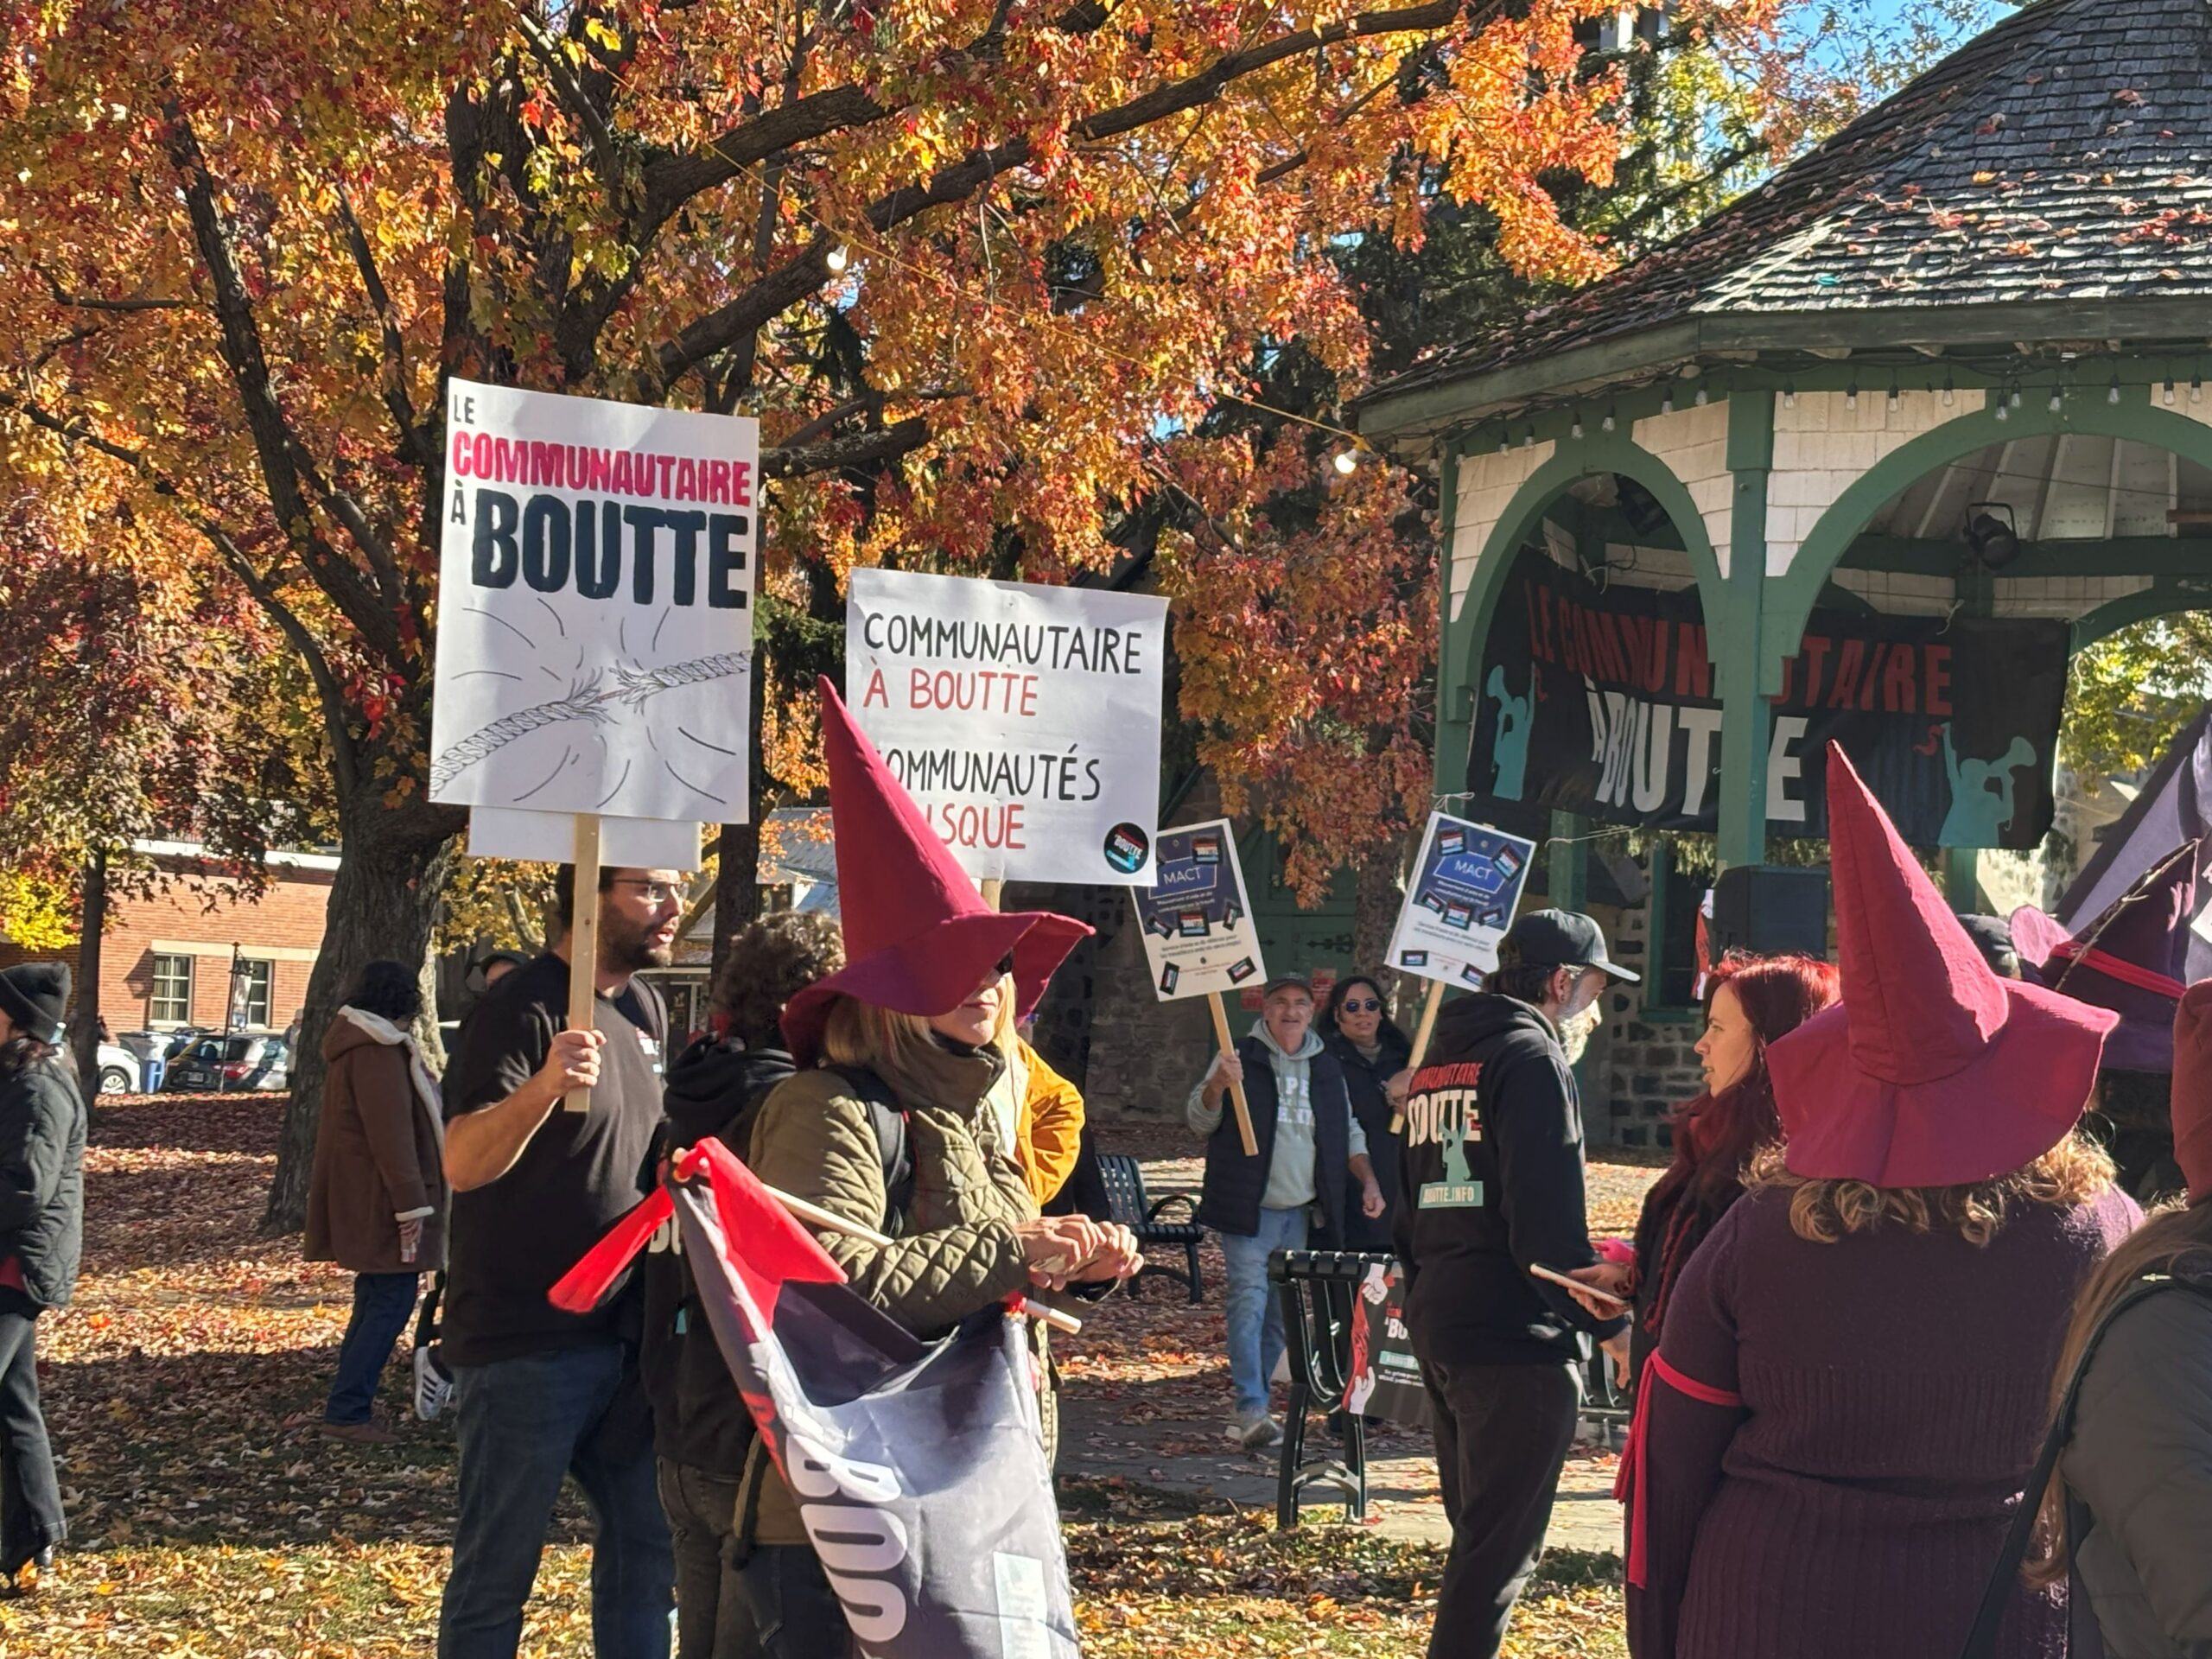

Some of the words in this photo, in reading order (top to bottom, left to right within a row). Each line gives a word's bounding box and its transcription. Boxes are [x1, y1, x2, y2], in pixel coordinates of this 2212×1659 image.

[454, 394, 474, 424] LE
[453, 430, 751, 506] COMMUNAUTAIRE
[450, 479, 467, 525] À
[471, 488, 748, 609] BOUTTE
[864, 613, 1142, 674] COMMUNAUTAIRE
[1526, 579, 1556, 664] LE
[1559, 597, 1953, 715] COMMUNTAIRE
[863, 656, 890, 709] À
[910, 668, 1039, 716] BOUTTE
[877, 743, 1101, 801] OMMUNAUTÉS
[1595, 688, 1808, 822] BOUTE
[926, 803, 1026, 849] ISQUE
[1163, 867, 1202, 885] MACT
[1454, 860, 1494, 880] MACT
